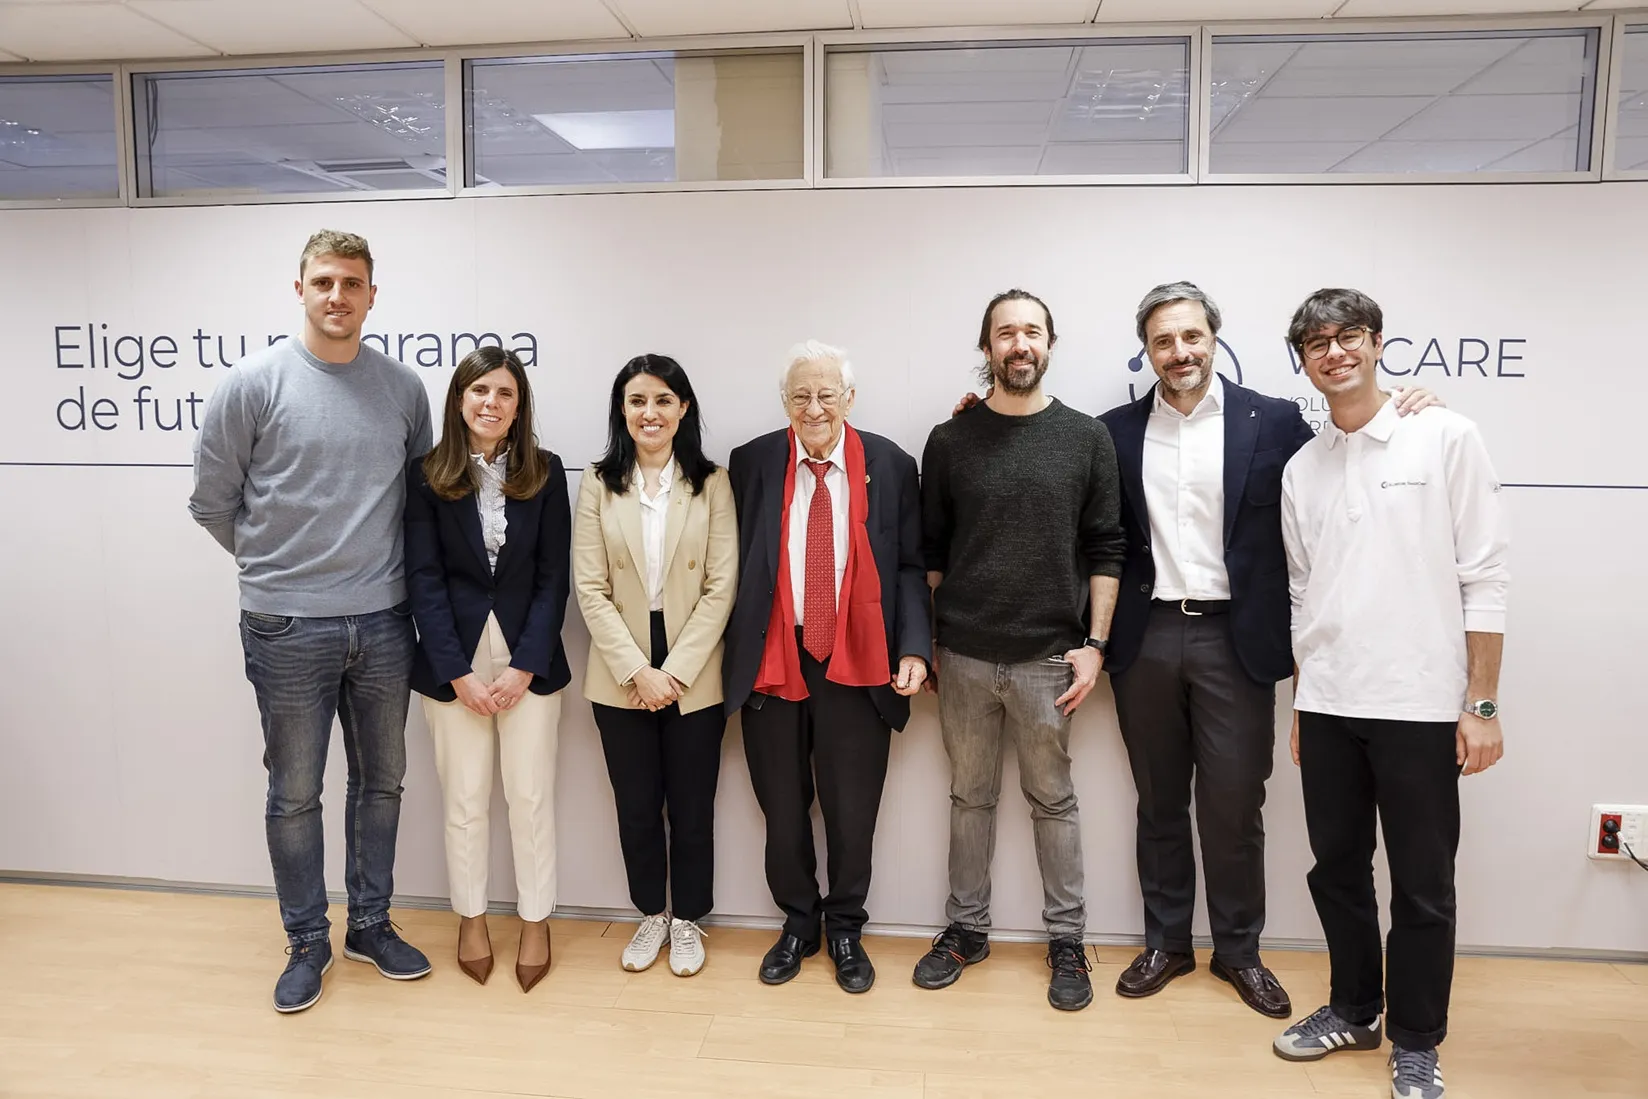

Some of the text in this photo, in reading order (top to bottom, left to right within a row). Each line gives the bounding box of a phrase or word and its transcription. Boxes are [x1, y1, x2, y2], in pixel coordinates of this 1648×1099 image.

[54, 323, 179, 380] Elige
[192, 328, 246, 368] tu
[56, 385, 205, 431] de fut
